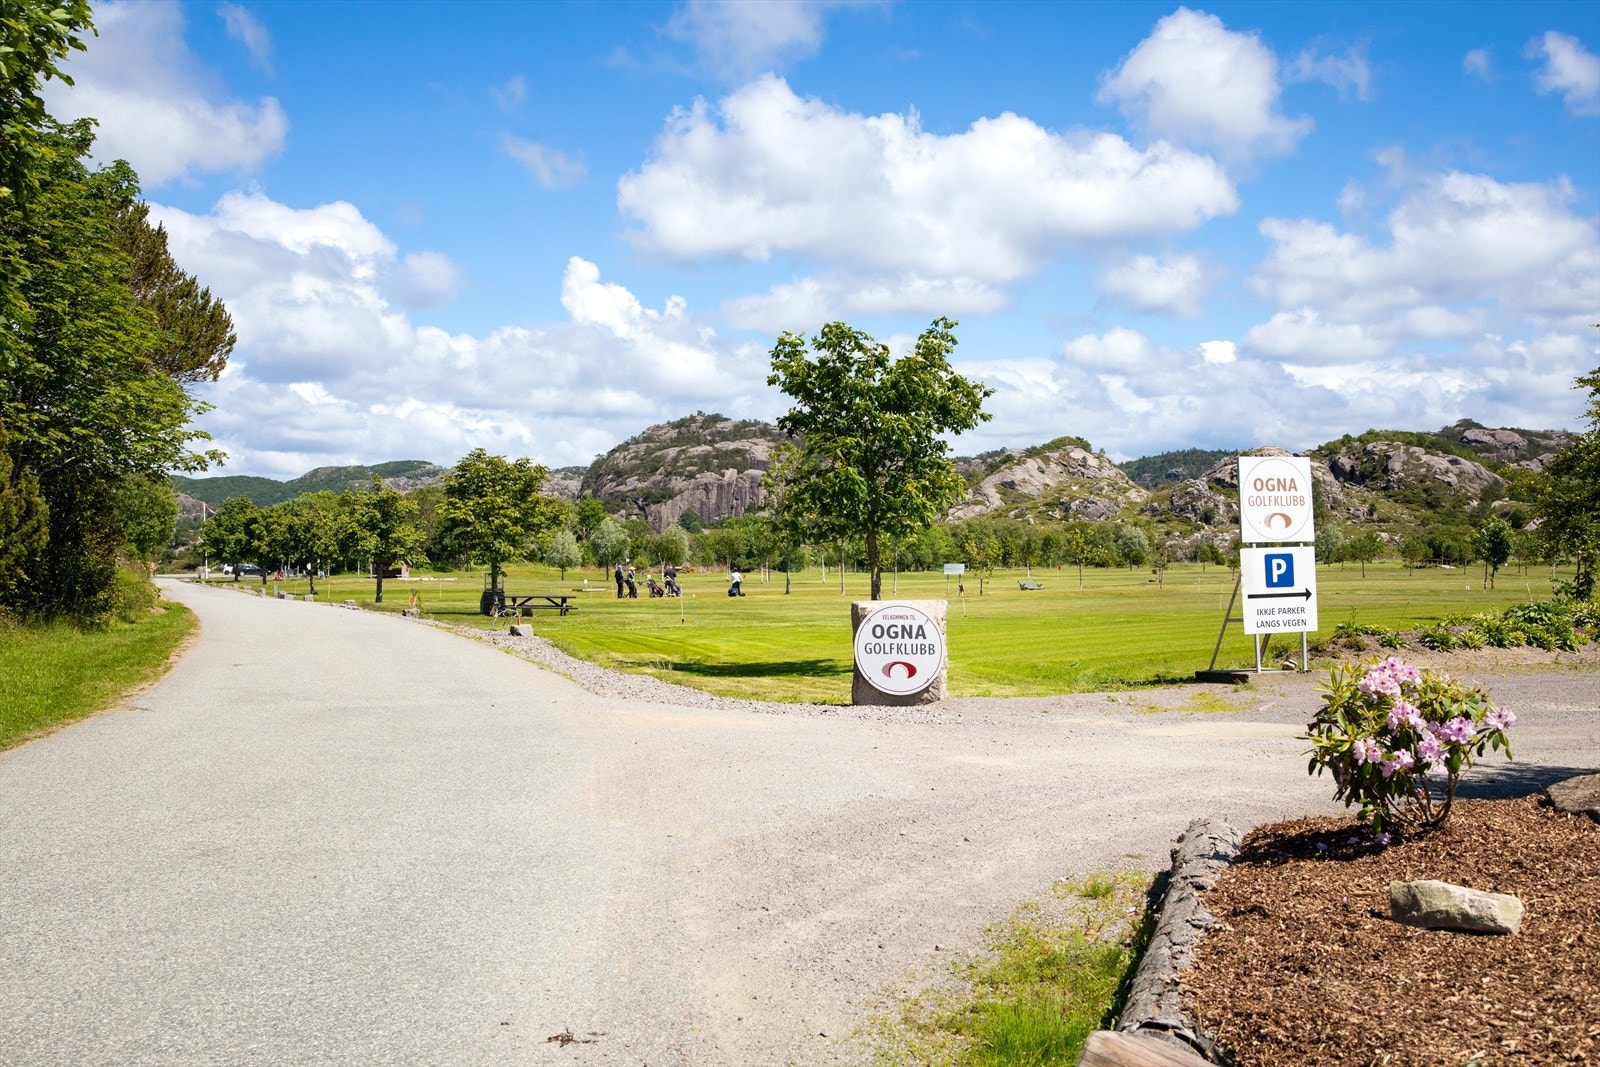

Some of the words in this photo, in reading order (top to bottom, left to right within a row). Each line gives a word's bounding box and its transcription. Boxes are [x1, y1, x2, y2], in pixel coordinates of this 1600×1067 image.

[1253, 477, 1298, 492] OGNA
[1247, 495, 1306, 507] GOLFKLUBB
[1271, 558, 1287, 583] P
[1256, 608, 1276, 616] IKKJE
[1278, 606, 1306, 615] PARKER
[1256, 620, 1281, 629] LANGS
[1282, 618, 1307, 627] VEGEN
[871, 624, 927, 640] OGNA
[864, 642, 936, 655] GOLFKLUBB
